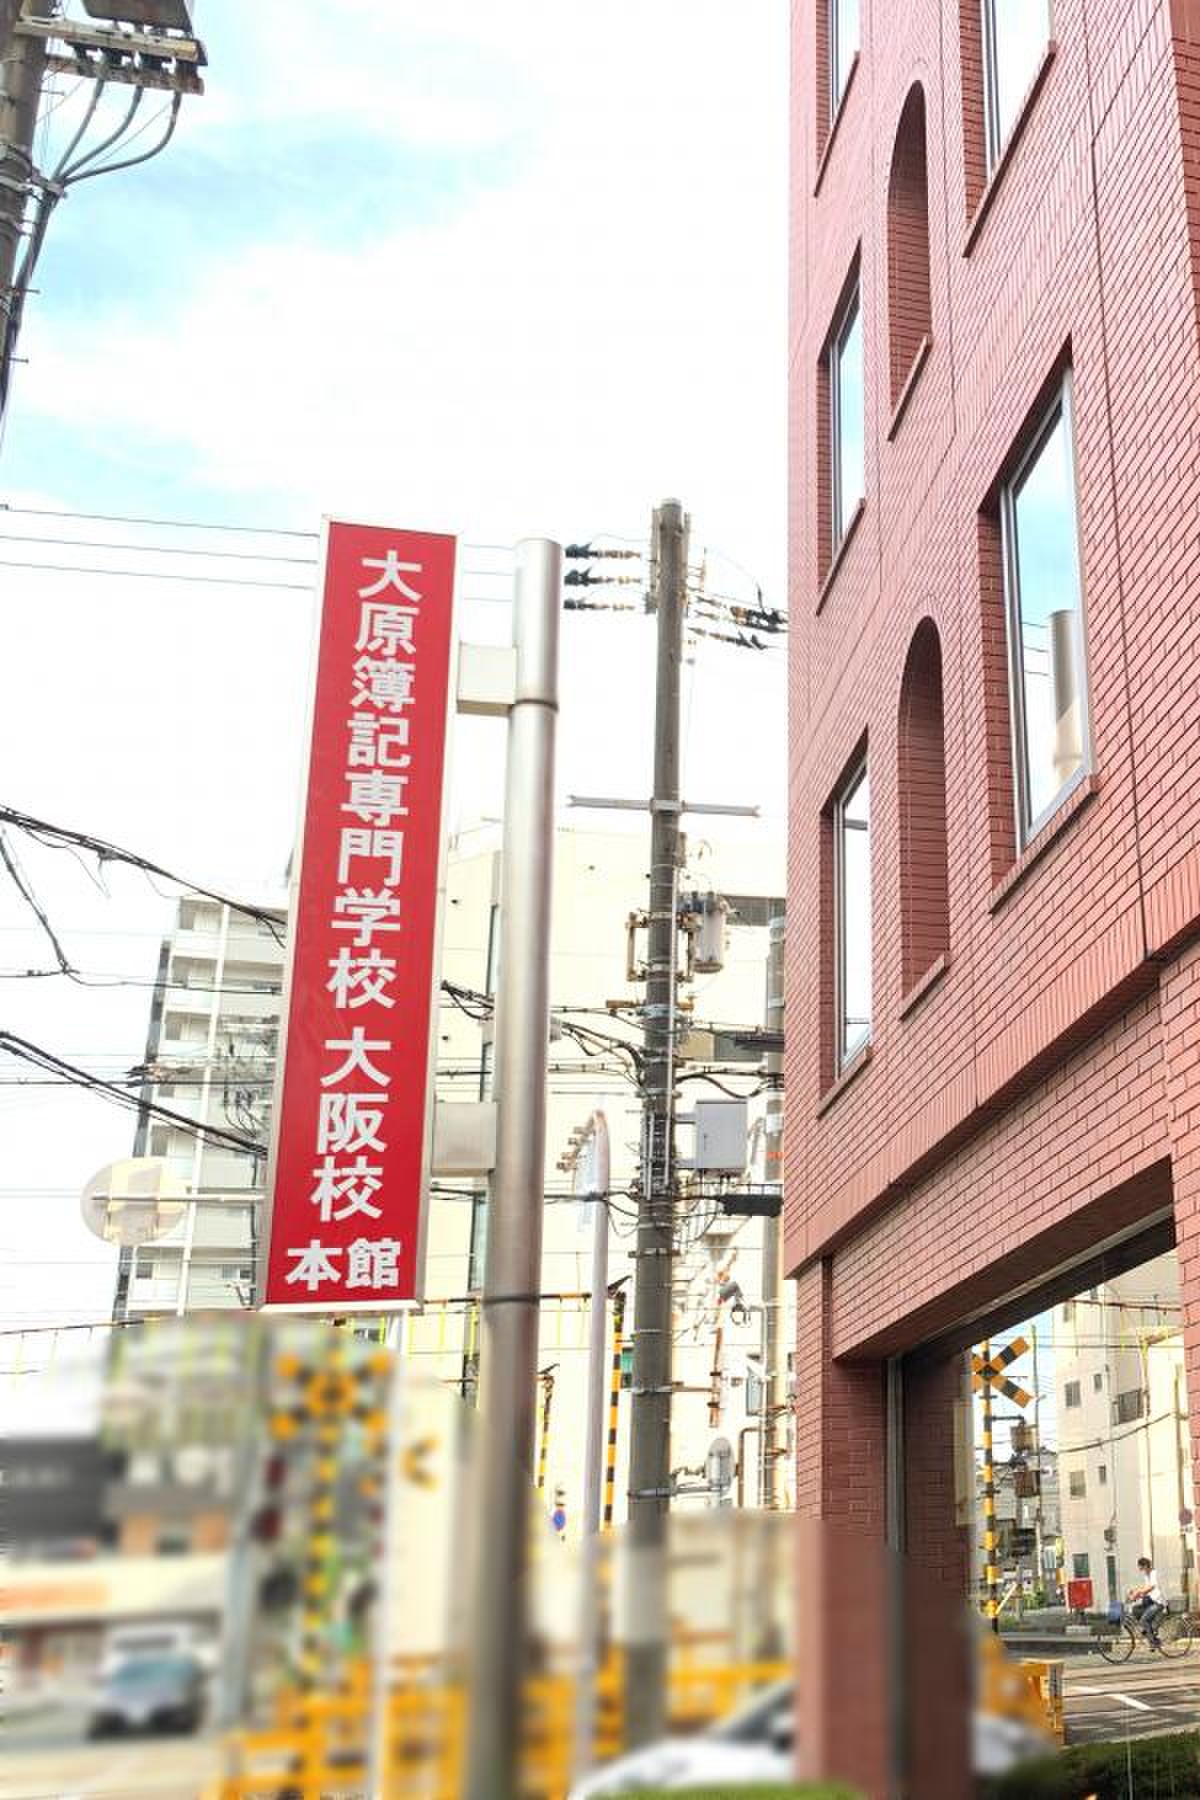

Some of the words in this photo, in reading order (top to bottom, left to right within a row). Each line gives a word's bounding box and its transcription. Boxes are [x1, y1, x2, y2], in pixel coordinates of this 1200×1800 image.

[326, 549, 422, 1011] 大原簿記専門学校
[311, 1026, 391, 1223] 大阪校
[285, 1238, 401, 1291] 本館
